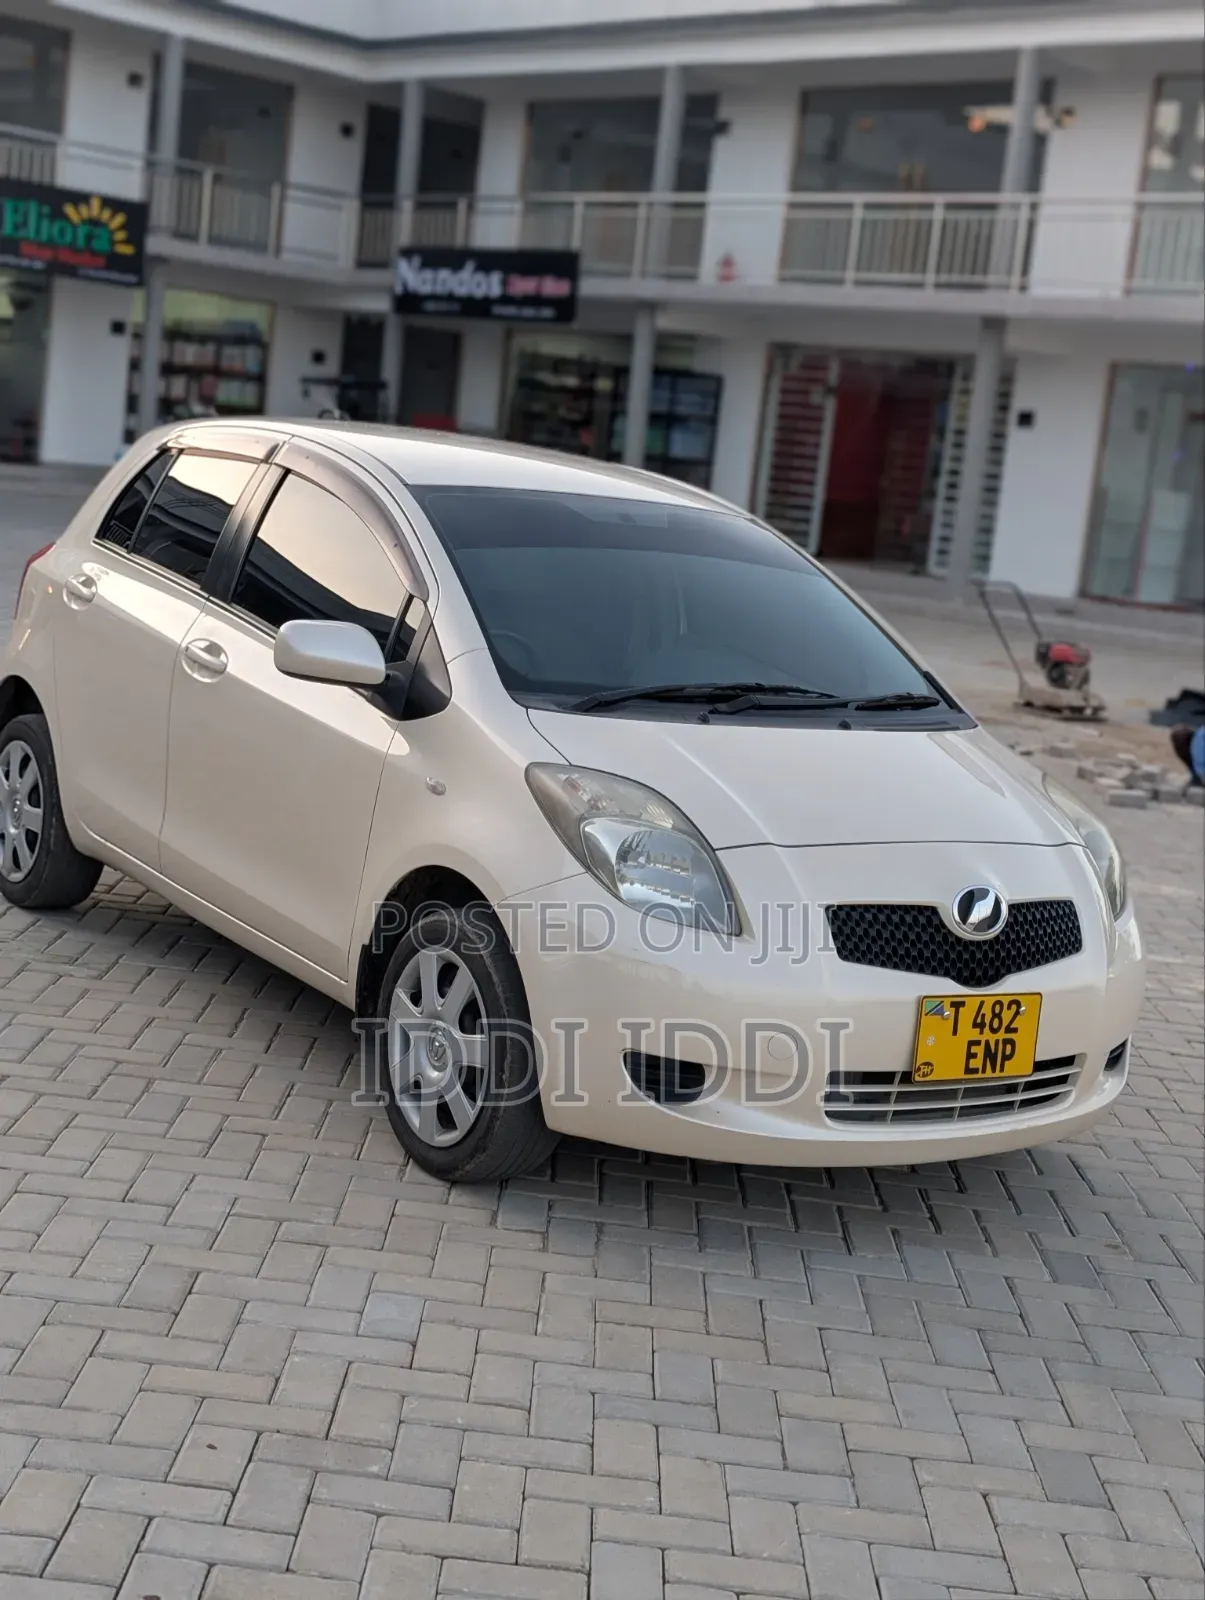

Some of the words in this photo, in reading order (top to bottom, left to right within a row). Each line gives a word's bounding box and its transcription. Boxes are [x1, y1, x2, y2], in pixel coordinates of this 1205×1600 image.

[3, 197, 111, 255] Eliora
[394, 255, 502, 299] Nandos
[949, 1001, 966, 1036] T
[971, 999, 1022, 1036] 482
[963, 1037, 1017, 1075] ENP
